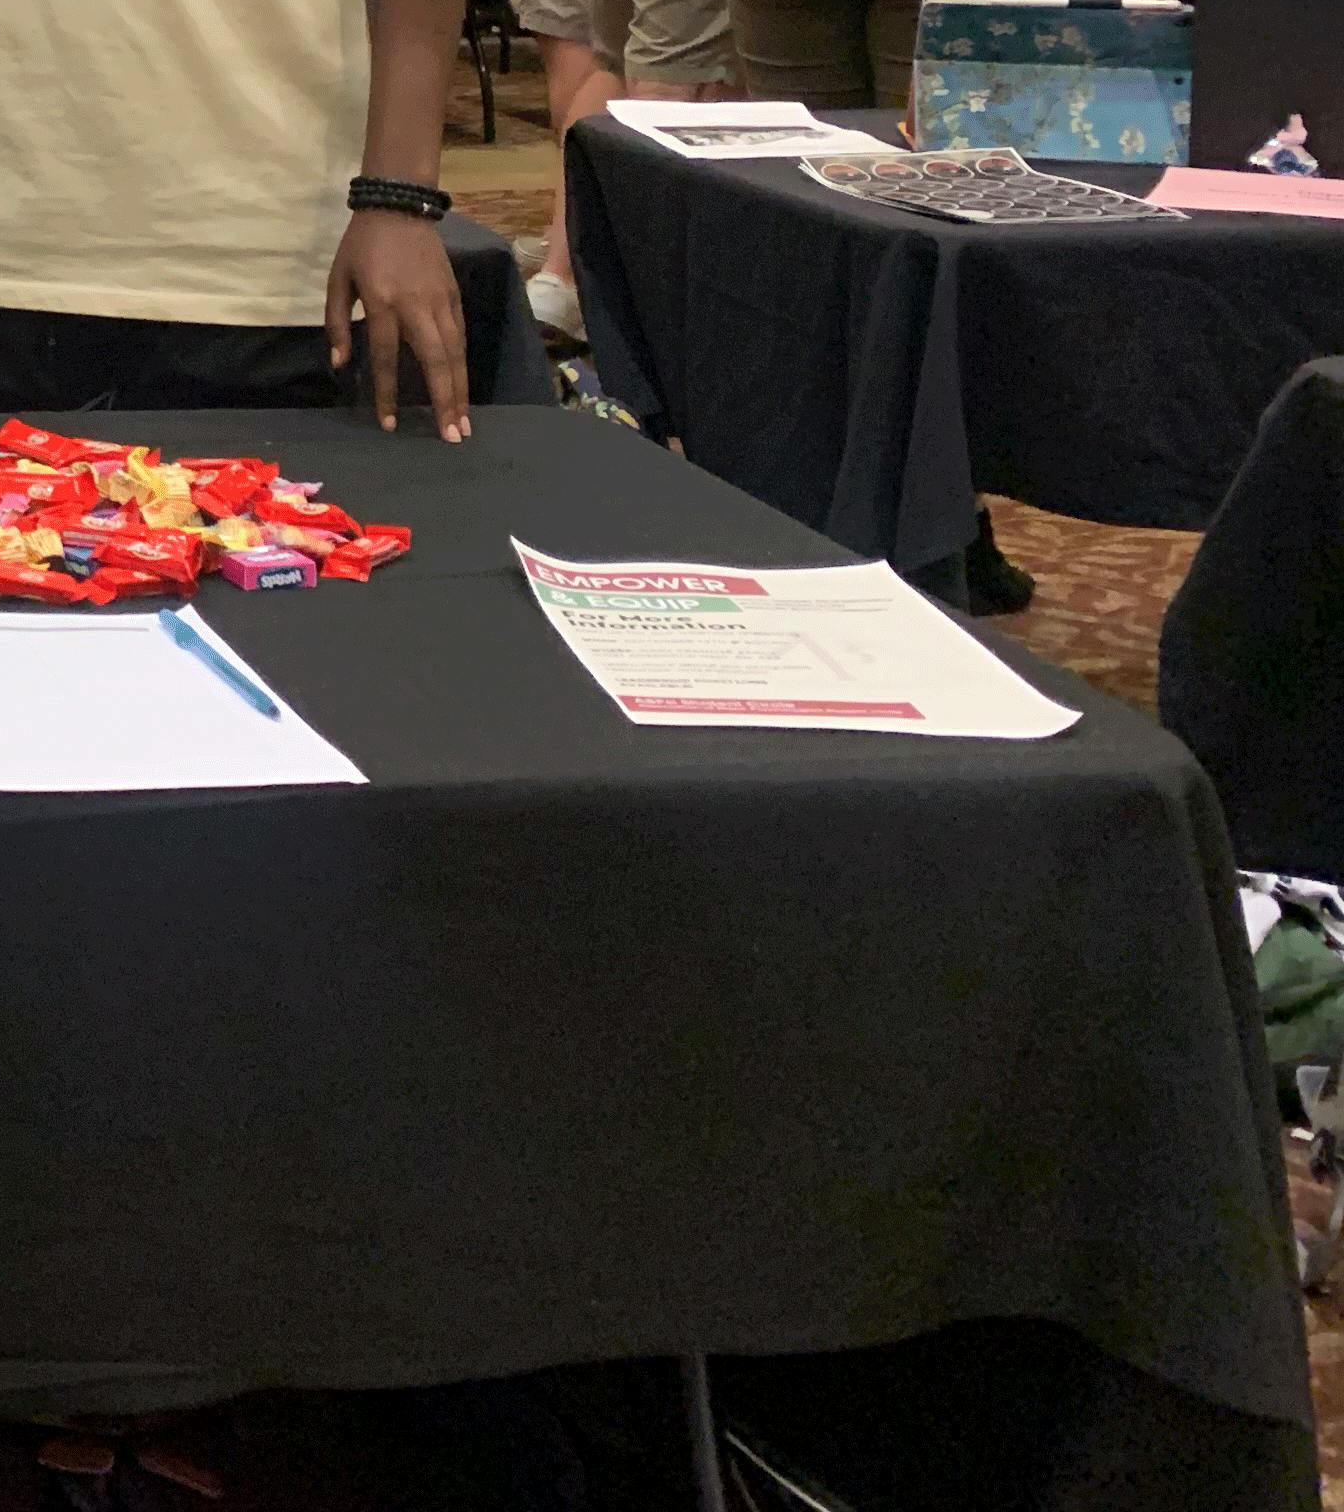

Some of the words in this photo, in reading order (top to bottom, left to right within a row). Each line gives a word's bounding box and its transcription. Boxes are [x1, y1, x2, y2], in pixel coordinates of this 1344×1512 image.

[535, 565, 730, 593] EMPOWER
[551, 590, 578, 606] &
[586, 595, 701, 610] EQUIP
[561, 610, 607, 621] For
[619, 614, 693, 622] More
[567, 619, 746, 630] Information
